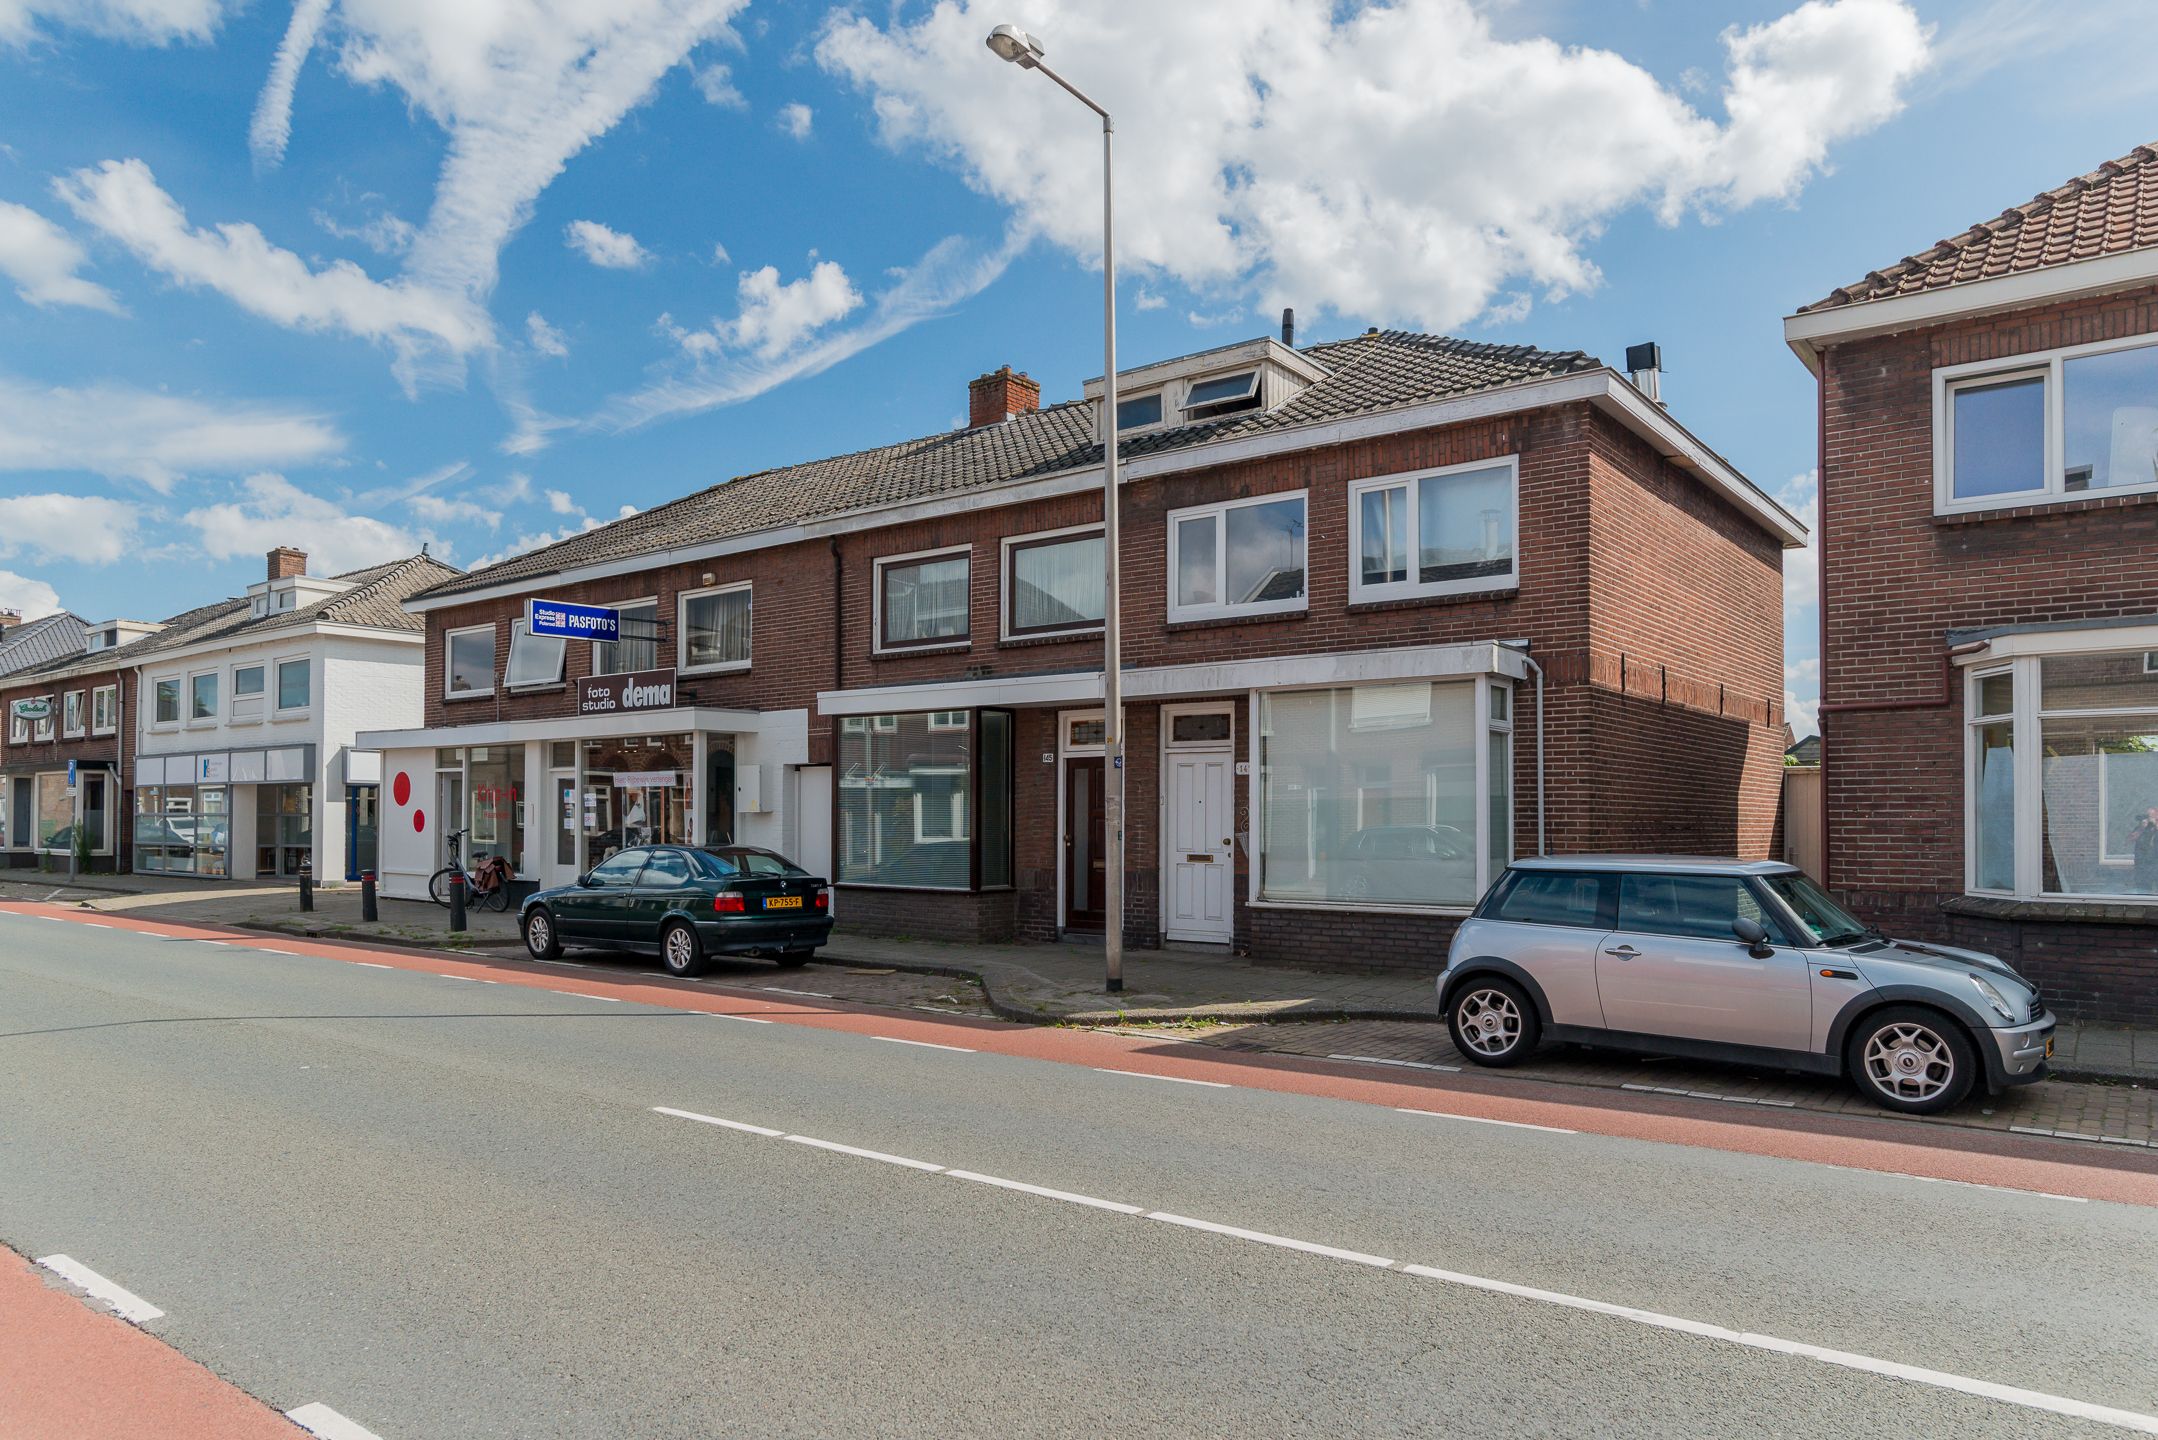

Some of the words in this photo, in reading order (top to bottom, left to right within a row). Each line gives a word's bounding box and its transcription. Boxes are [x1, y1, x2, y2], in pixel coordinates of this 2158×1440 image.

[569, 615, 616, 631] PASFOTO'S
[587, 687, 611, 699] foto
[622, 677, 671, 708] dema
[582, 698, 616, 711] studio
[1043, 754, 1053, 762] 145
